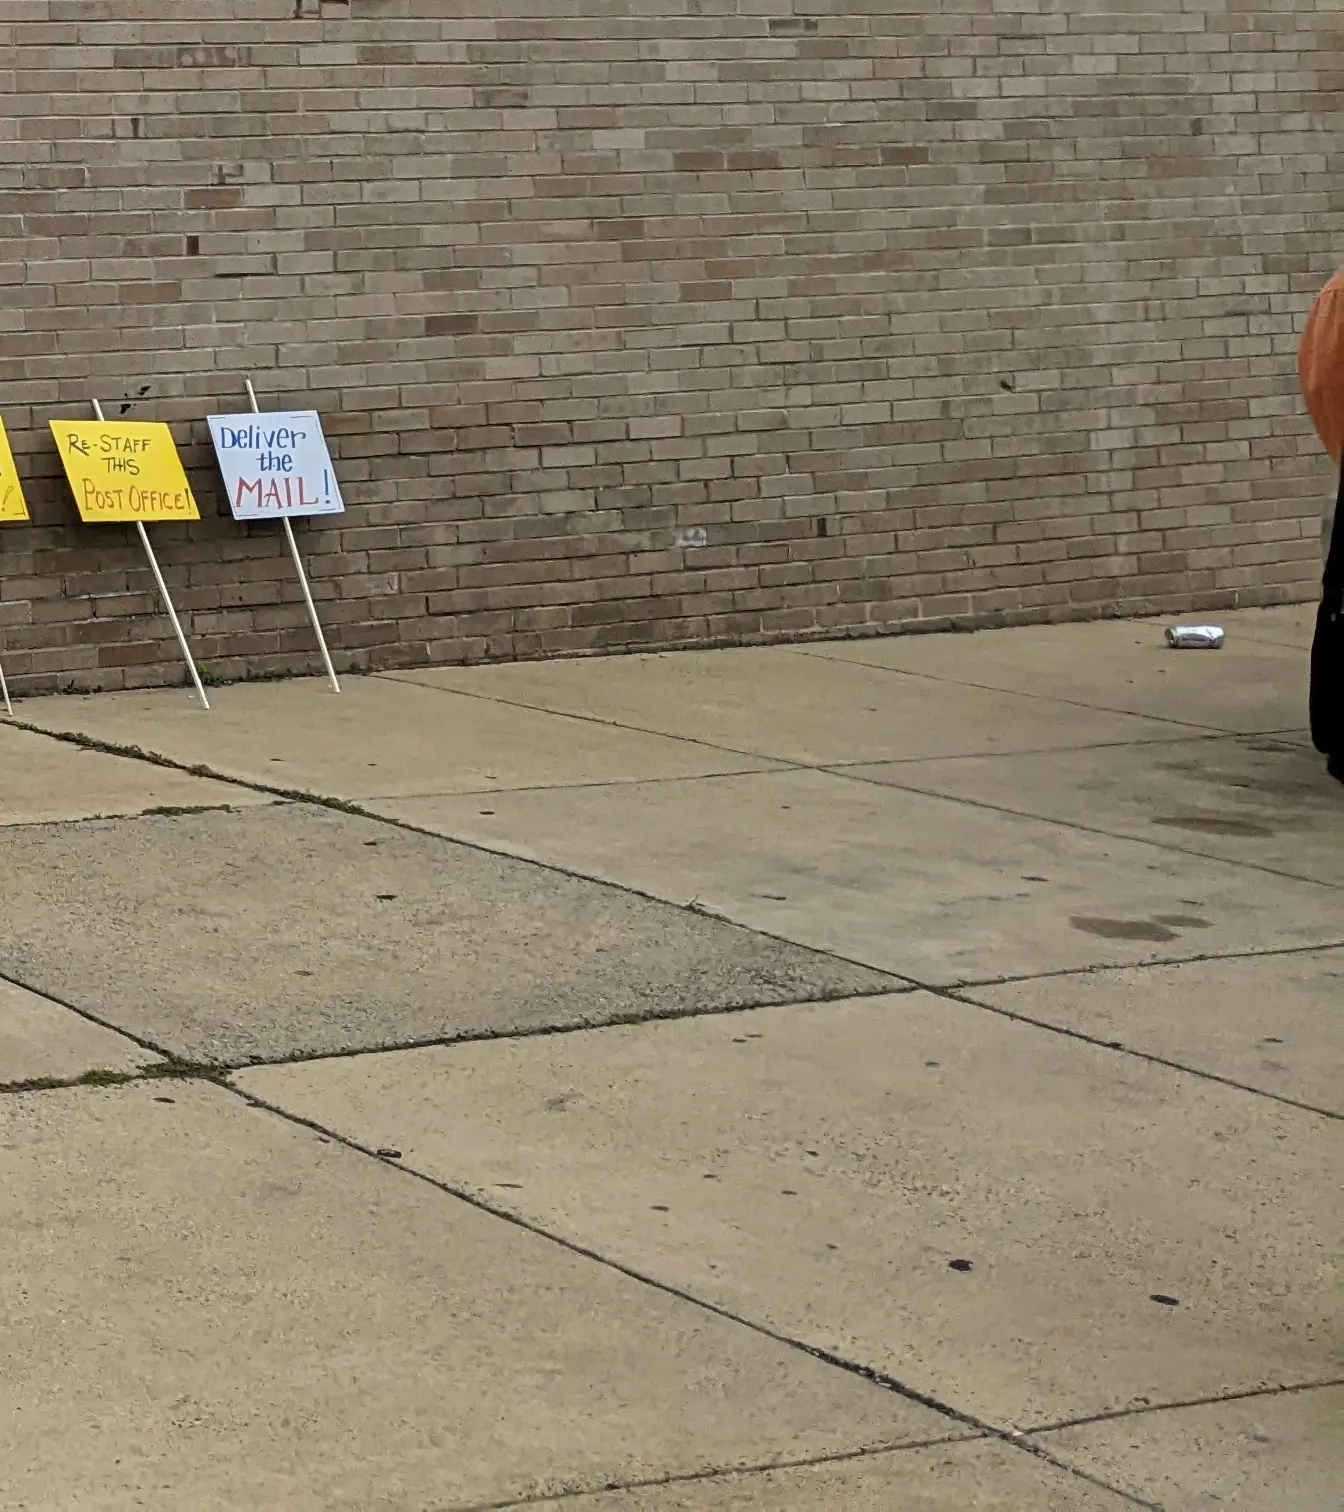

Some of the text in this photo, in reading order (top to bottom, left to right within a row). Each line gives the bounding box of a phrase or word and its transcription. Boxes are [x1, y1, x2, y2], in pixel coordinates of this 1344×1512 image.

[220, 424, 307, 450] Deliver
[101, 457, 140, 476] THIS
[255, 450, 294, 472] the
[81, 477, 192, 516] POST OFFICE!
[233, 468, 331, 509] MAIL!
